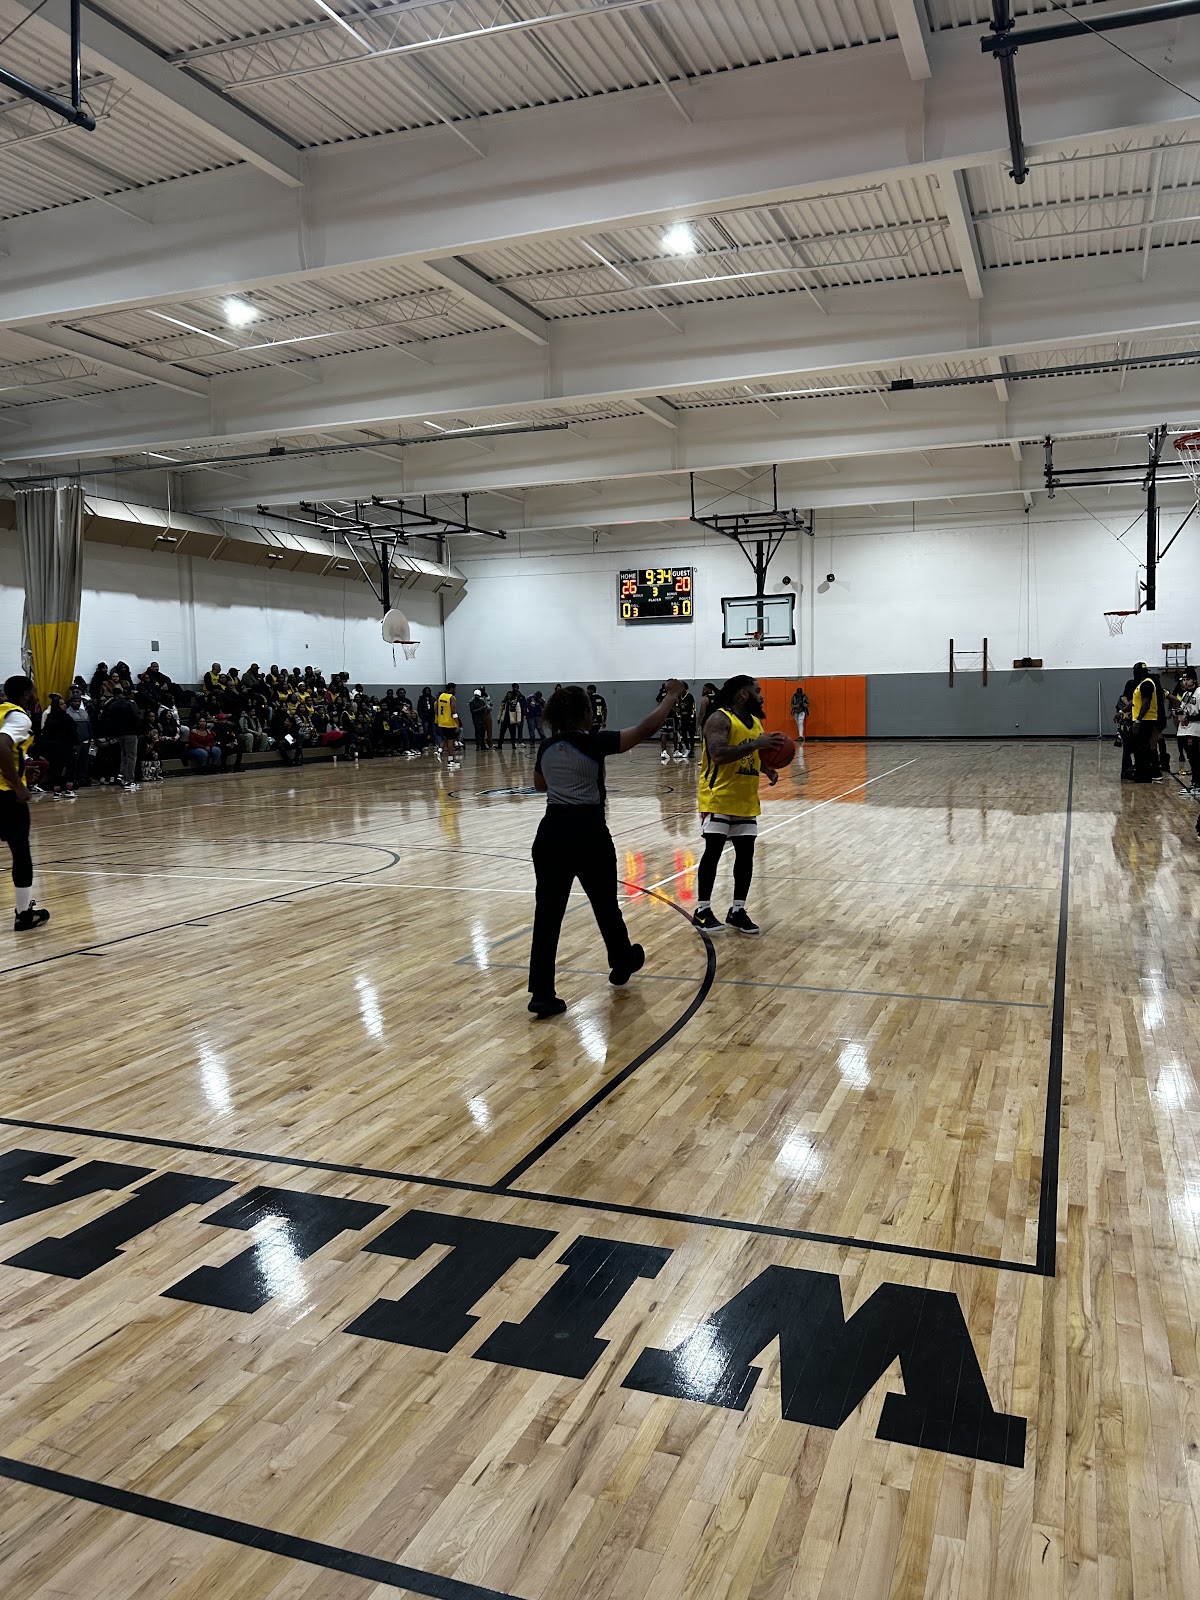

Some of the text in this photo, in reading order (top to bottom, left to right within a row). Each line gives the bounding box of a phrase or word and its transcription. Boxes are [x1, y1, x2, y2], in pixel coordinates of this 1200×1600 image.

[645, 569, 671, 585] 9:34
[675, 576, 691, 591] 20
[622, 580, 637, 594] 26
[652, 587, 658, 597] 3
[623, 604, 631, 618] 0
[633, 608, 639, 617] 3
[673, 606, 679, 615] 3
[683, 600, 691, 615] 0
